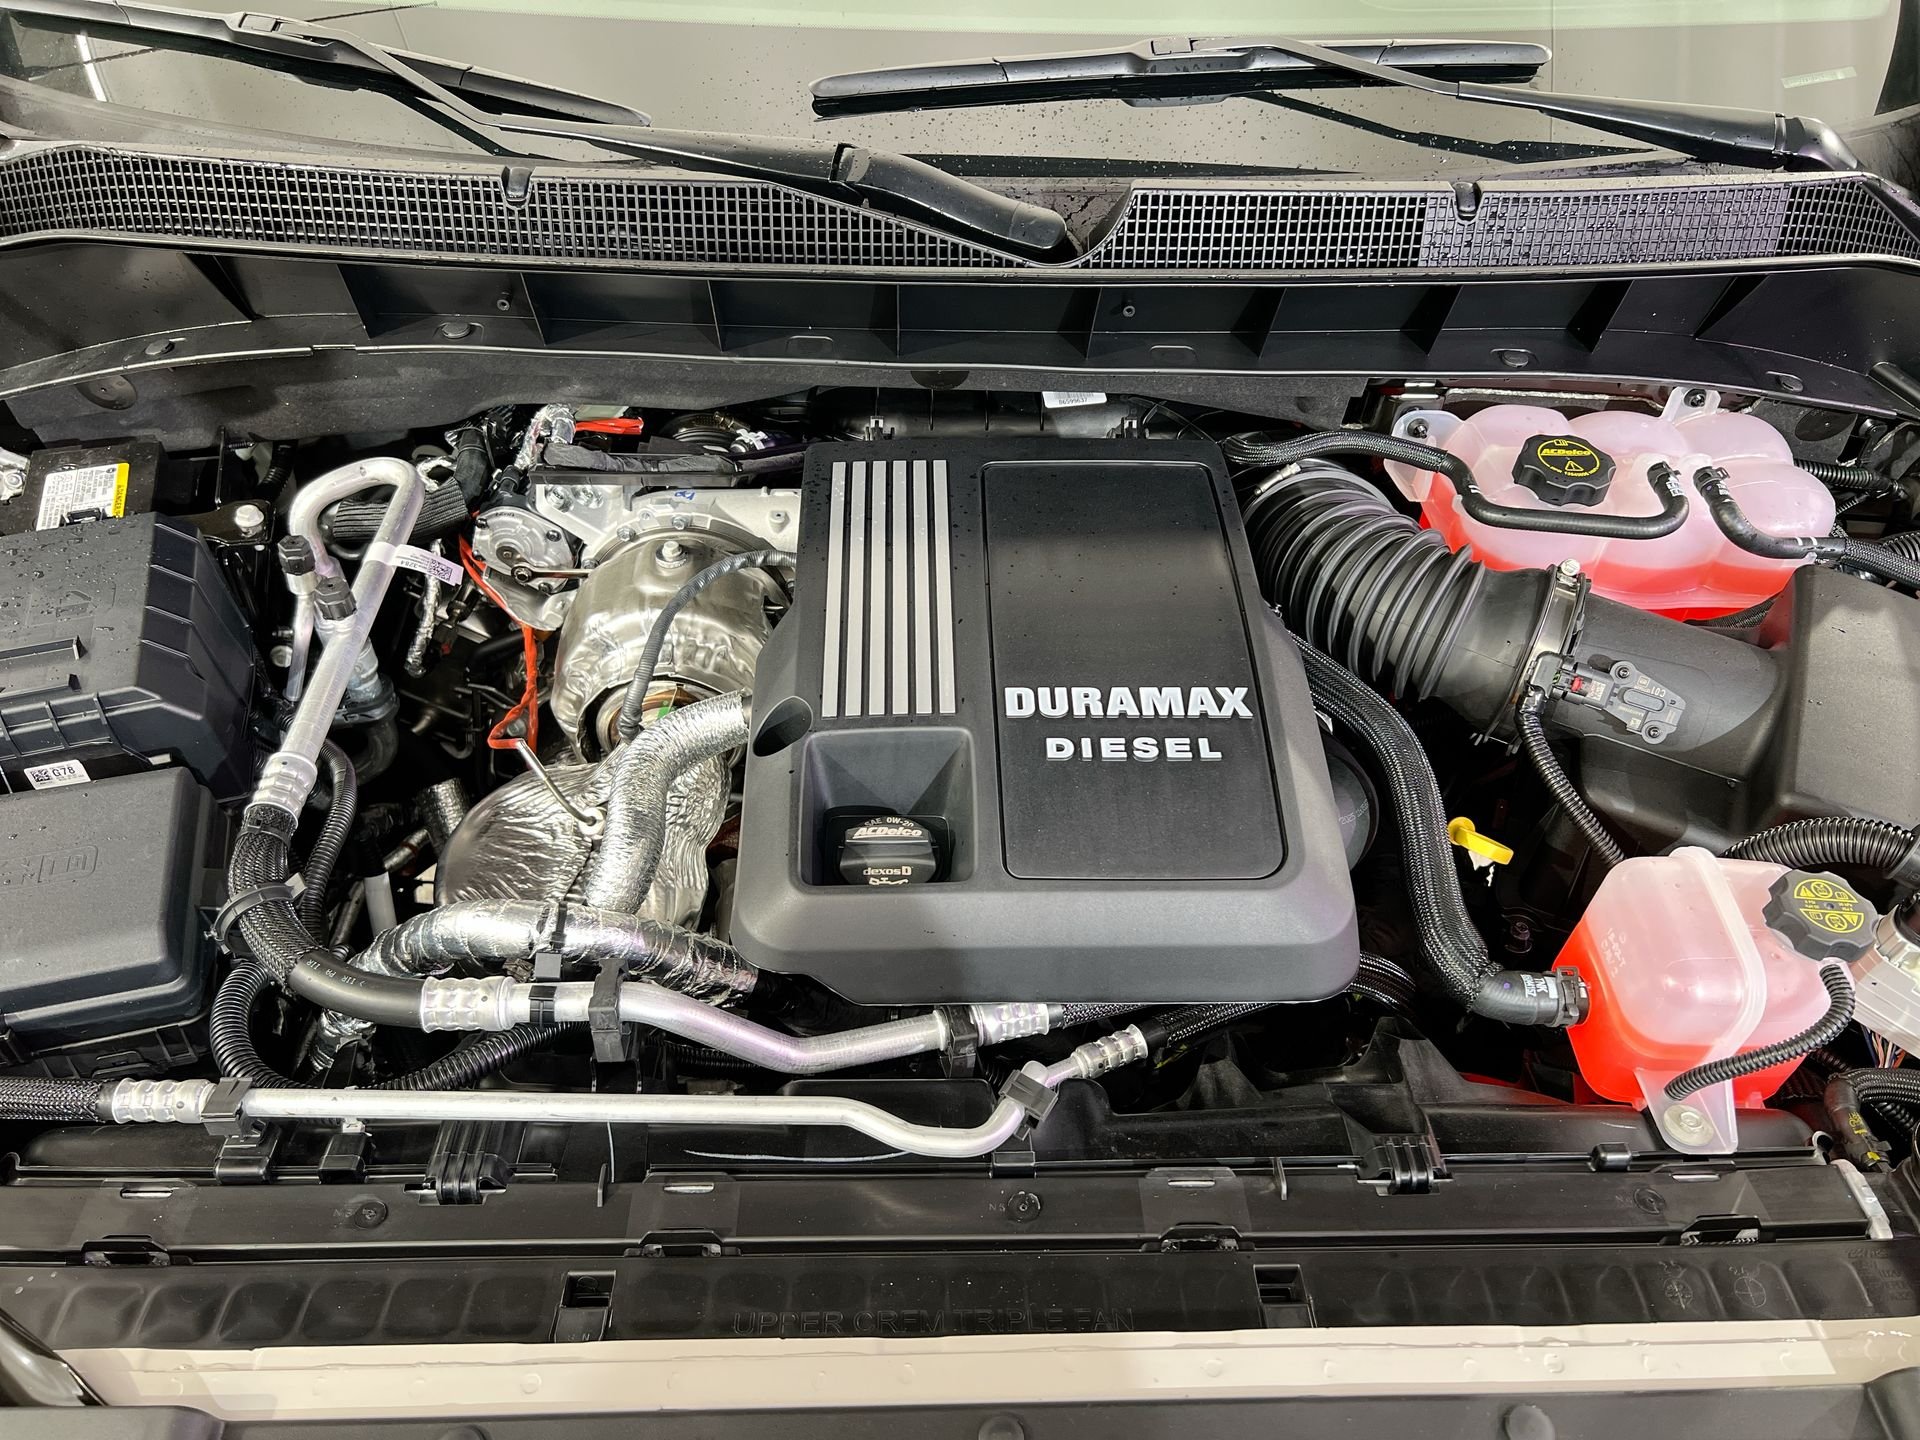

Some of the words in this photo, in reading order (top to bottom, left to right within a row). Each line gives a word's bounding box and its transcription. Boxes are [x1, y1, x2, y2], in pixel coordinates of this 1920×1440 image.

[1540, 448, 1592, 456] ACDelco
[1004, 686, 1254, 719] DURAMAX
[1045, 737, 1223, 762] DIESEL
[52, 766, 76, 777] G78
[864, 817, 883, 827] SAE
[853, 826, 923, 839] ACDelco
[733, 1310, 845, 1335] UPPER
[952, 1307, 1065, 1333] TRIPLE
[1072, 1307, 1137, 1333] FAN
